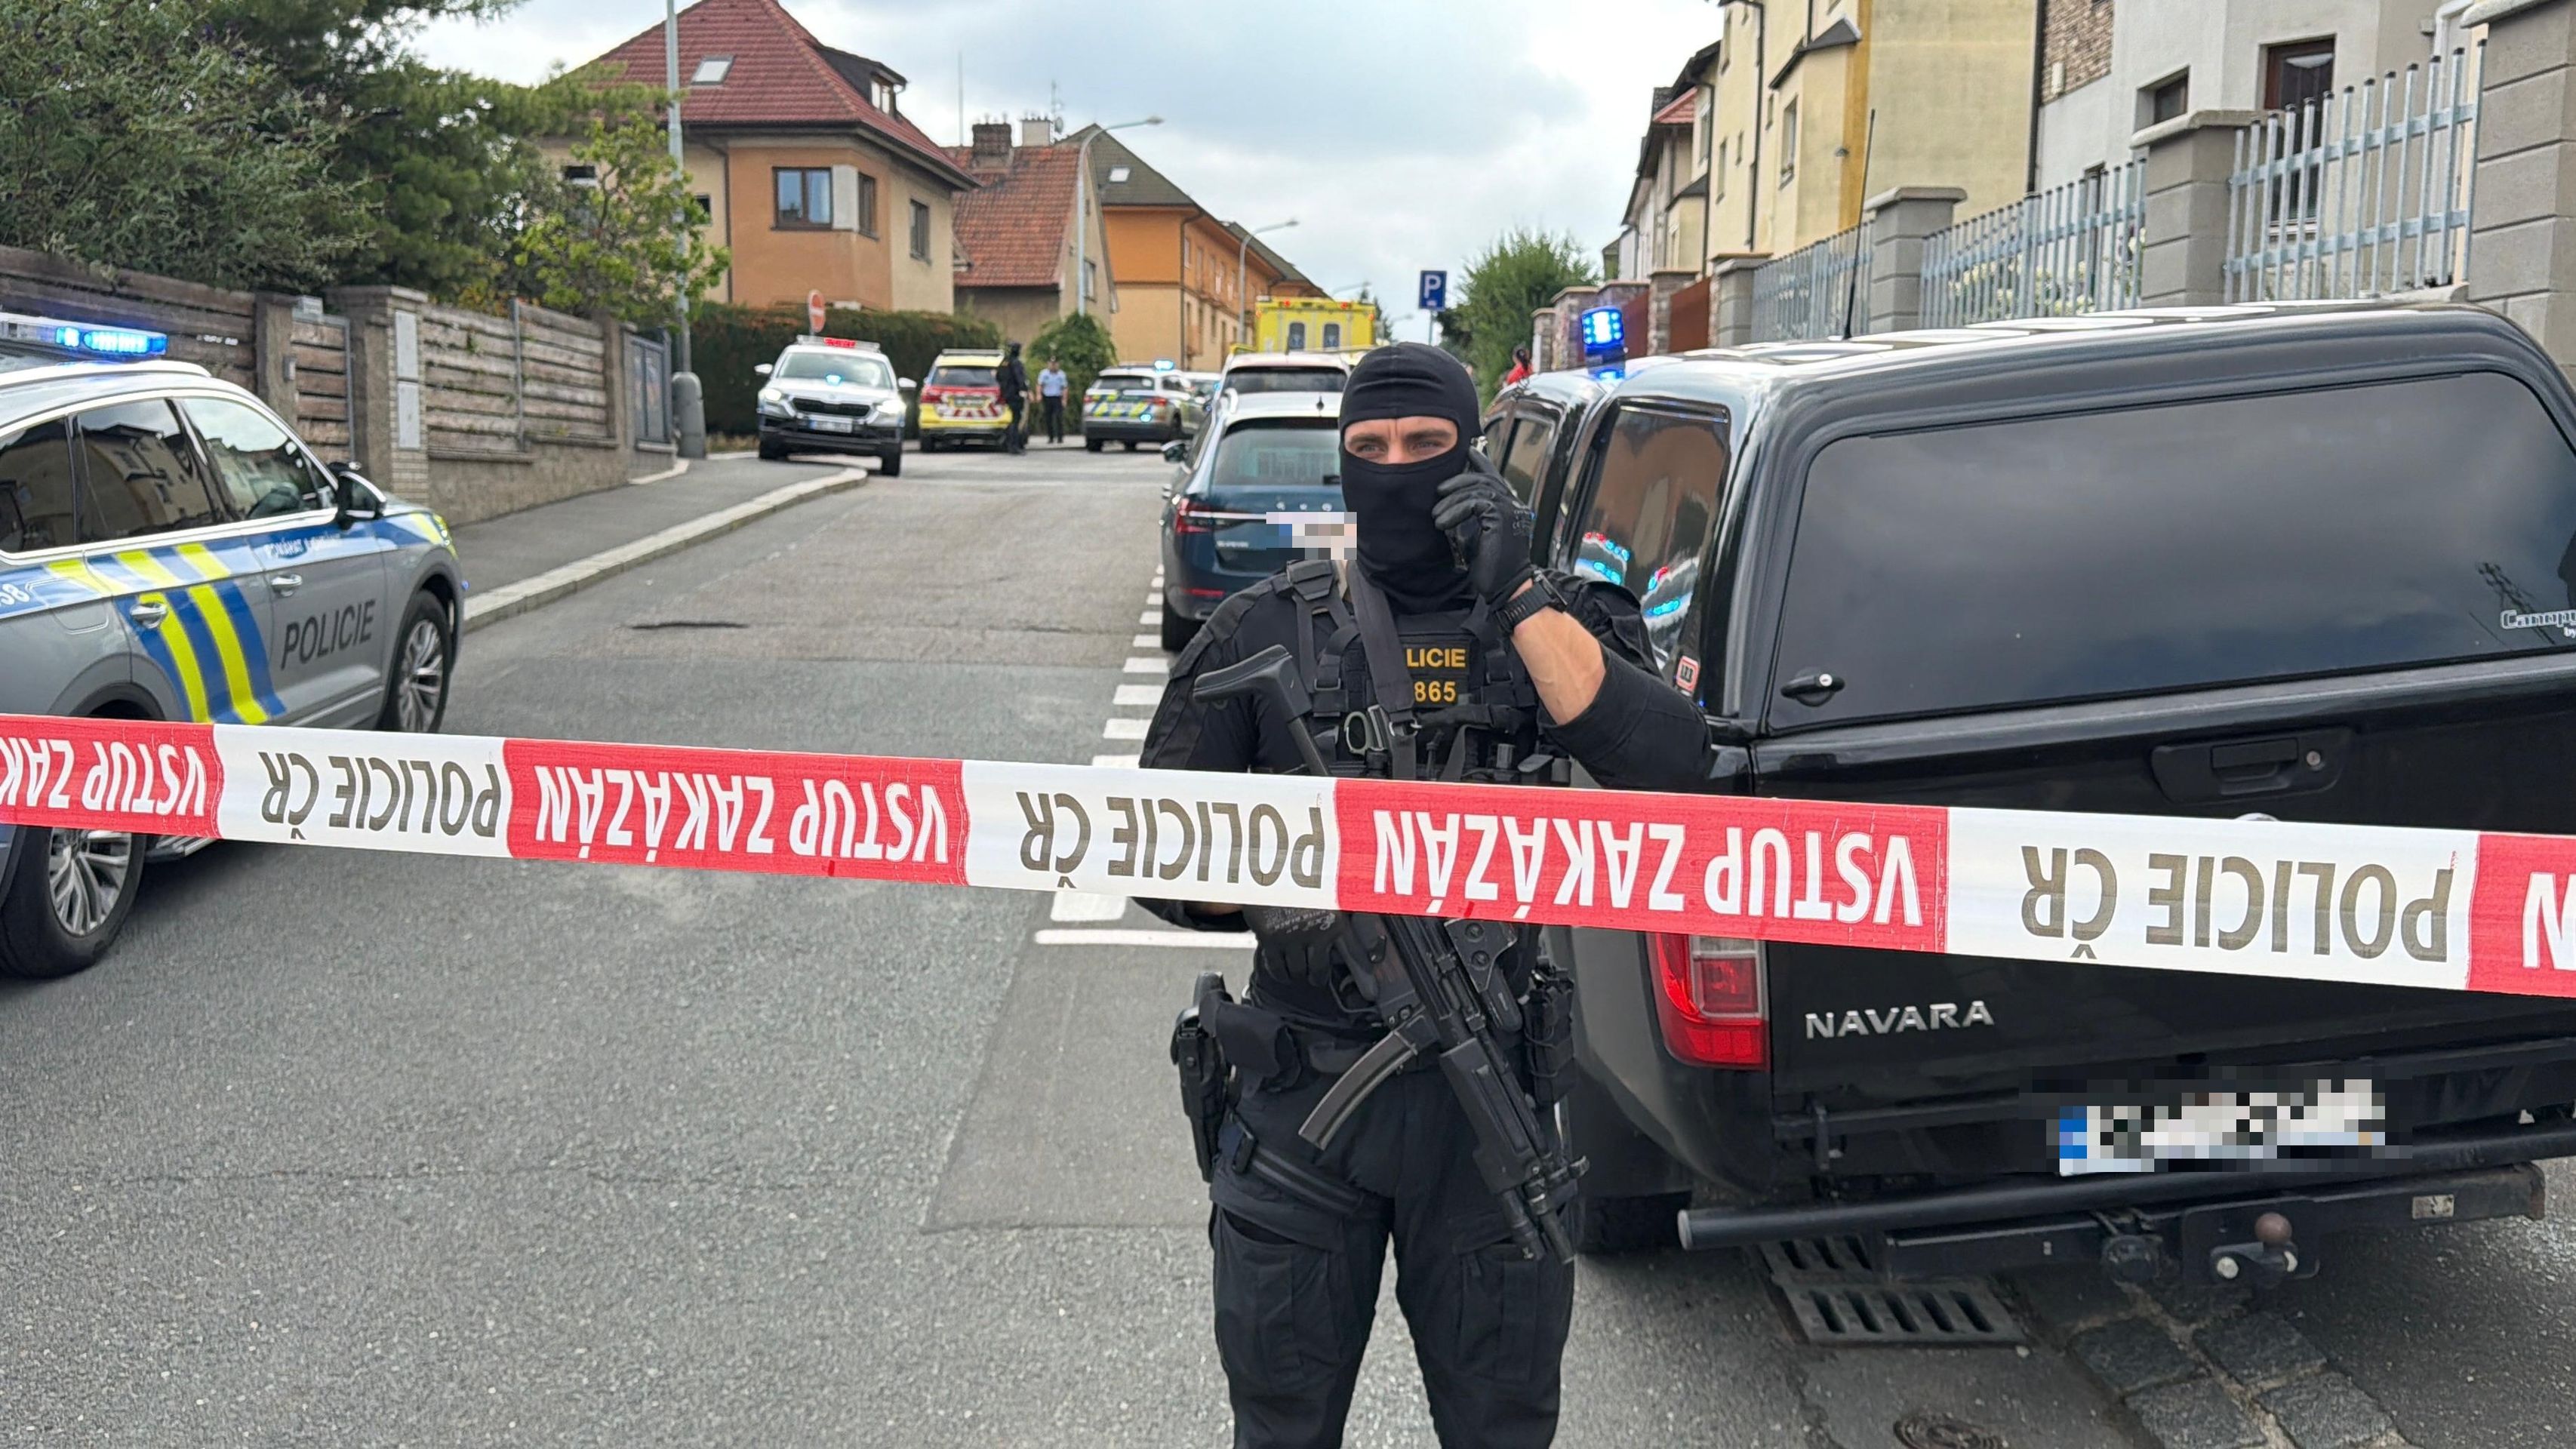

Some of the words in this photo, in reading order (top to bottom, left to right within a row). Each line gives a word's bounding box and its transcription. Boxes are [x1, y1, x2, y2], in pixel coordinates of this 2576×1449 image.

[1423, 274, 1442, 299] P
[0, 583, 30, 606] 58
[281, 599, 376, 670] POLICIE
[1406, 648, 1466, 668] LICIE
[1414, 681, 1456, 702] 865
[82, 741, 207, 817] VSTUP
[258, 752, 319, 840] ČR
[328, 755, 501, 838] POLICIE
[534, 765, 774, 863] ZAKÁZÁN
[789, 779, 948, 864] VSTUP
[1015, 792, 1091, 889] ČR
[1106, 796, 1325, 889] POLICIE
[1373, 810, 1685, 919] ZAKÁZÁN
[1703, 827, 1923, 927] VSTUP
[2020, 845, 2117, 959] ČR
[2146, 853, 2452, 962] POLICIE
[1805, 1001, 1994, 1038] NAVARA
